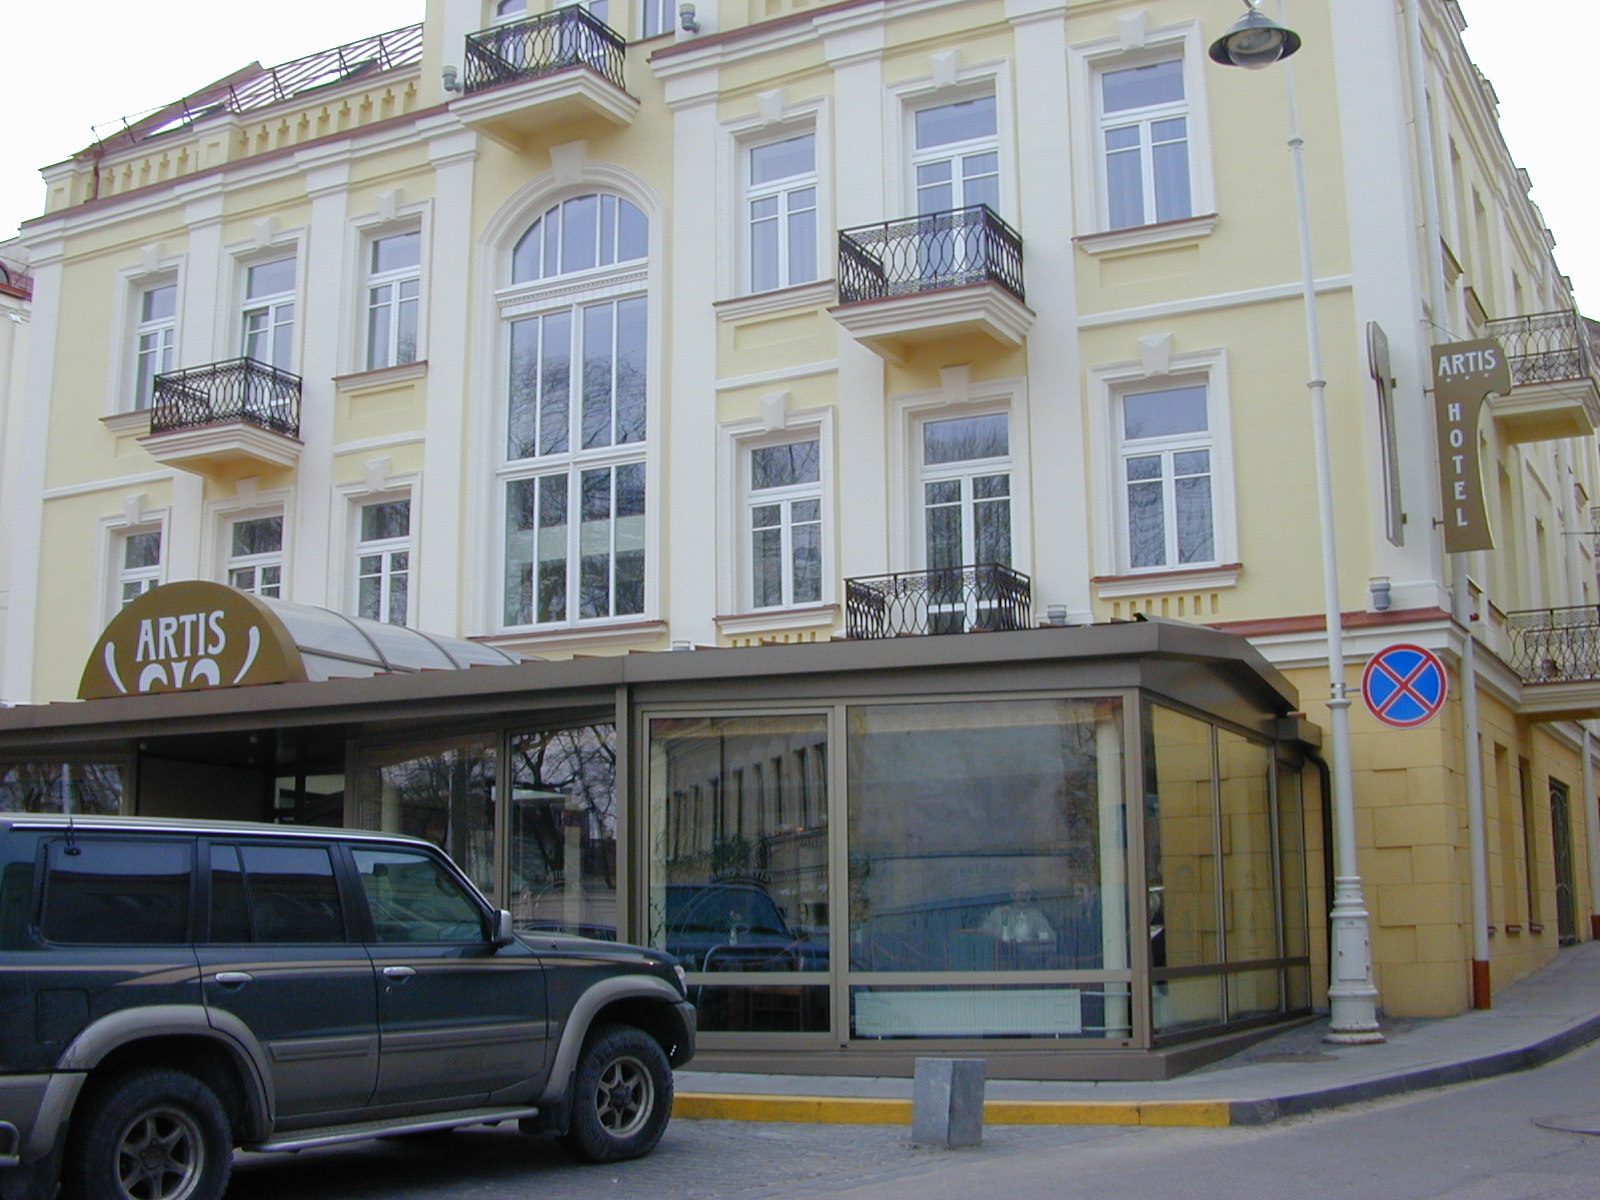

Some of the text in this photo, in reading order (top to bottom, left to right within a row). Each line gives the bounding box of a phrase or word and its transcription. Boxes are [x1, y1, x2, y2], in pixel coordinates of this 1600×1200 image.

[1438, 349, 1496, 377] ARTIS
[1448, 403, 1468, 526] HOTEL
[135, 610, 226, 663] ARTIS
